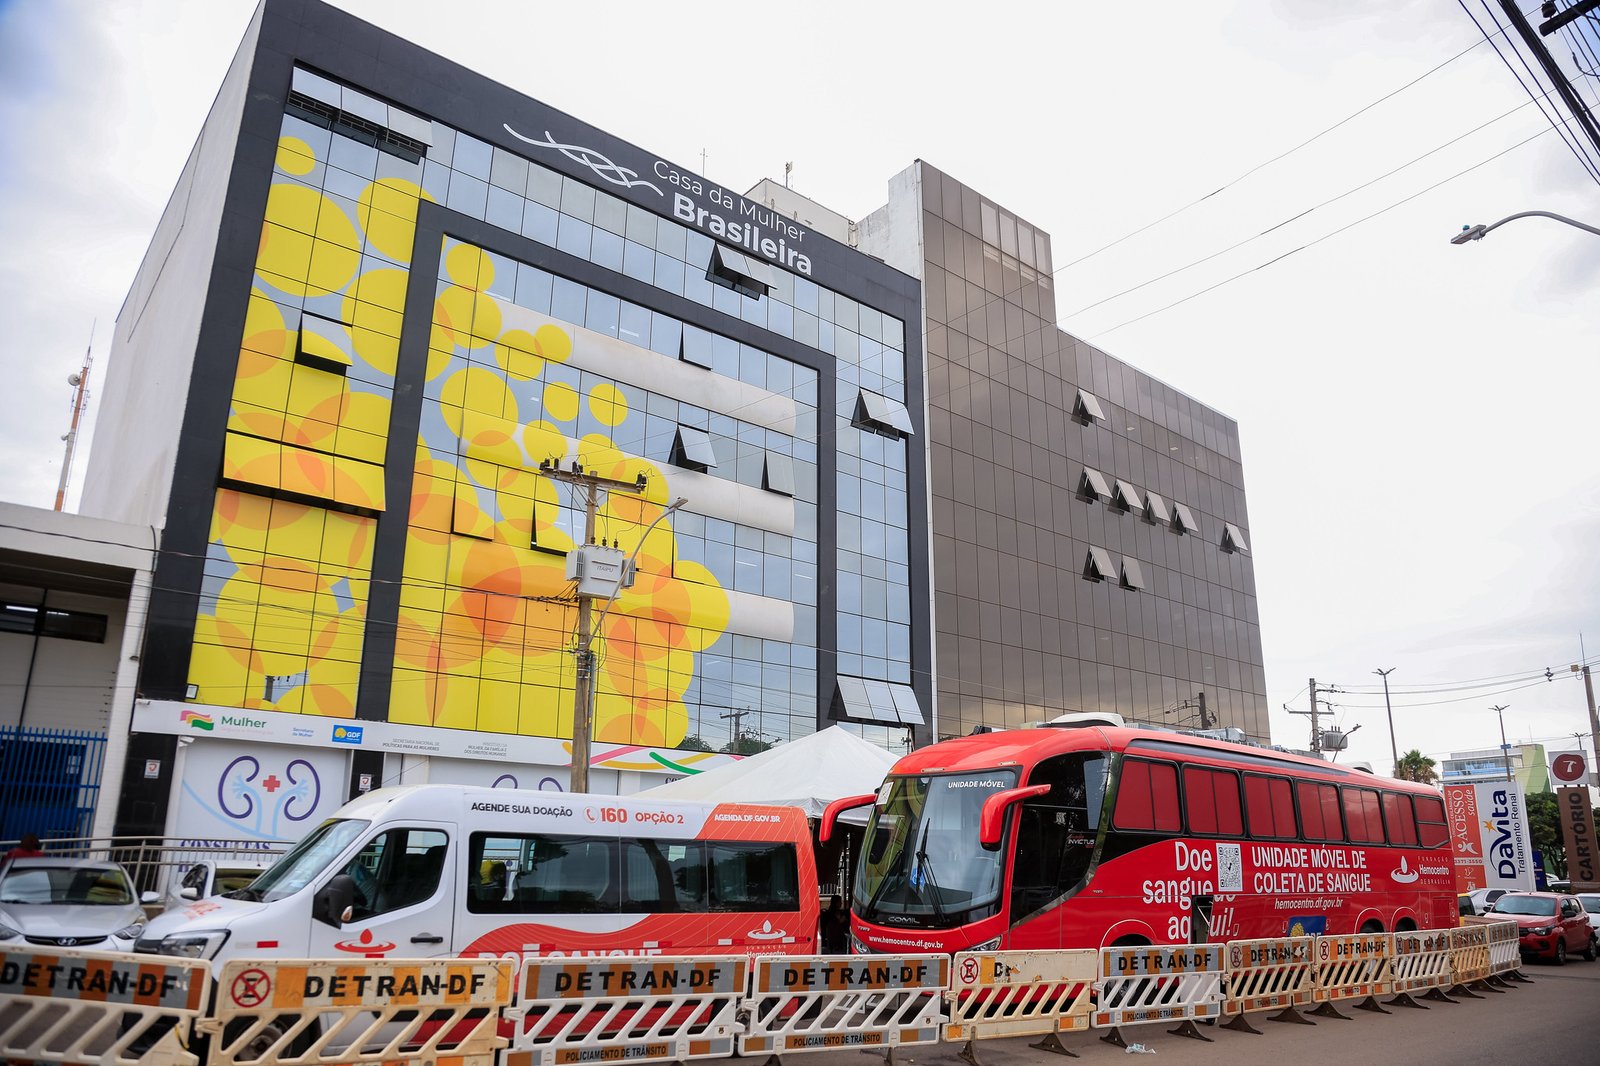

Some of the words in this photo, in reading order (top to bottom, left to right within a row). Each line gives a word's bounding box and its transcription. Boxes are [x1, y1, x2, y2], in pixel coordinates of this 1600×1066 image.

[654, 160, 703, 196] Casa
[709, 187, 733, 210] da
[740, 198, 806, 242] Mulher
[673, 192, 812, 276] Brasileira
[221, 716, 267, 728] Mulher
[346, 731, 361, 739] GDF
[948, 781, 979, 789] UNIDADE
[979, 779, 1005, 788] MÓVEL
[471, 802, 511, 813] AGENDE
[512, 804, 531, 814] SUA
[533, 805, 573, 818] DOAÇÃO
[600, 807, 628, 824] 160
[635, 811, 675, 825] OPÇÃO
[677, 814, 684, 824] 2
[1464, 789, 1476, 817] saúde
[1509, 793, 1519, 820] Renal
[714, 813, 781, 823] AGENDA.DF.GOV.BR
[1452, 789, 1468, 841] ACESSO
[1490, 789, 1517, 879] DaVita
[1568, 792, 1594, 882] CARTÓRIO
[1175, 841, 1213, 872] Doe
[1252, 846, 1309, 868] UNIDADE
[1311, 844, 1351, 869] MÓVEL
[1352, 850, 1367, 869] DE
[1513, 822, 1526, 875] Tratamento
[1418, 863, 1450, 876] Hemocentro
[1254, 872, 1306, 894] COLETA
[1308, 872, 1325, 893] DE
[1327, 872, 1372, 893] SANGUE
[1275, 896, 1344, 911] hemocentro.df.gov.br
[888, 916, 921, 924] COMIL
[868, 935, 944, 949] www.hemocentro.df.gov.br
[1337, 940, 1386, 956] DETRAN-DF
[1118, 953, 1212, 970] DETRAN-DF
[1, 961, 178, 998] DETRAN-DF
[303, 974, 486, 998] DETRAN-DF
[555, 969, 721, 992] DETRAN-DF
[784, 966, 928, 986] DETRAN-DF
[794, 1036, 840, 1047] POLICIAMENTO
[841, 1036, 849, 1044] DE
[850, 1033, 881, 1043] TRÂNSITO
[565, 1048, 619, 1062] POLICIAMENTO
[620, 1047, 630, 1058] DE
[631, 1045, 667, 1057] TRÂNSITO
